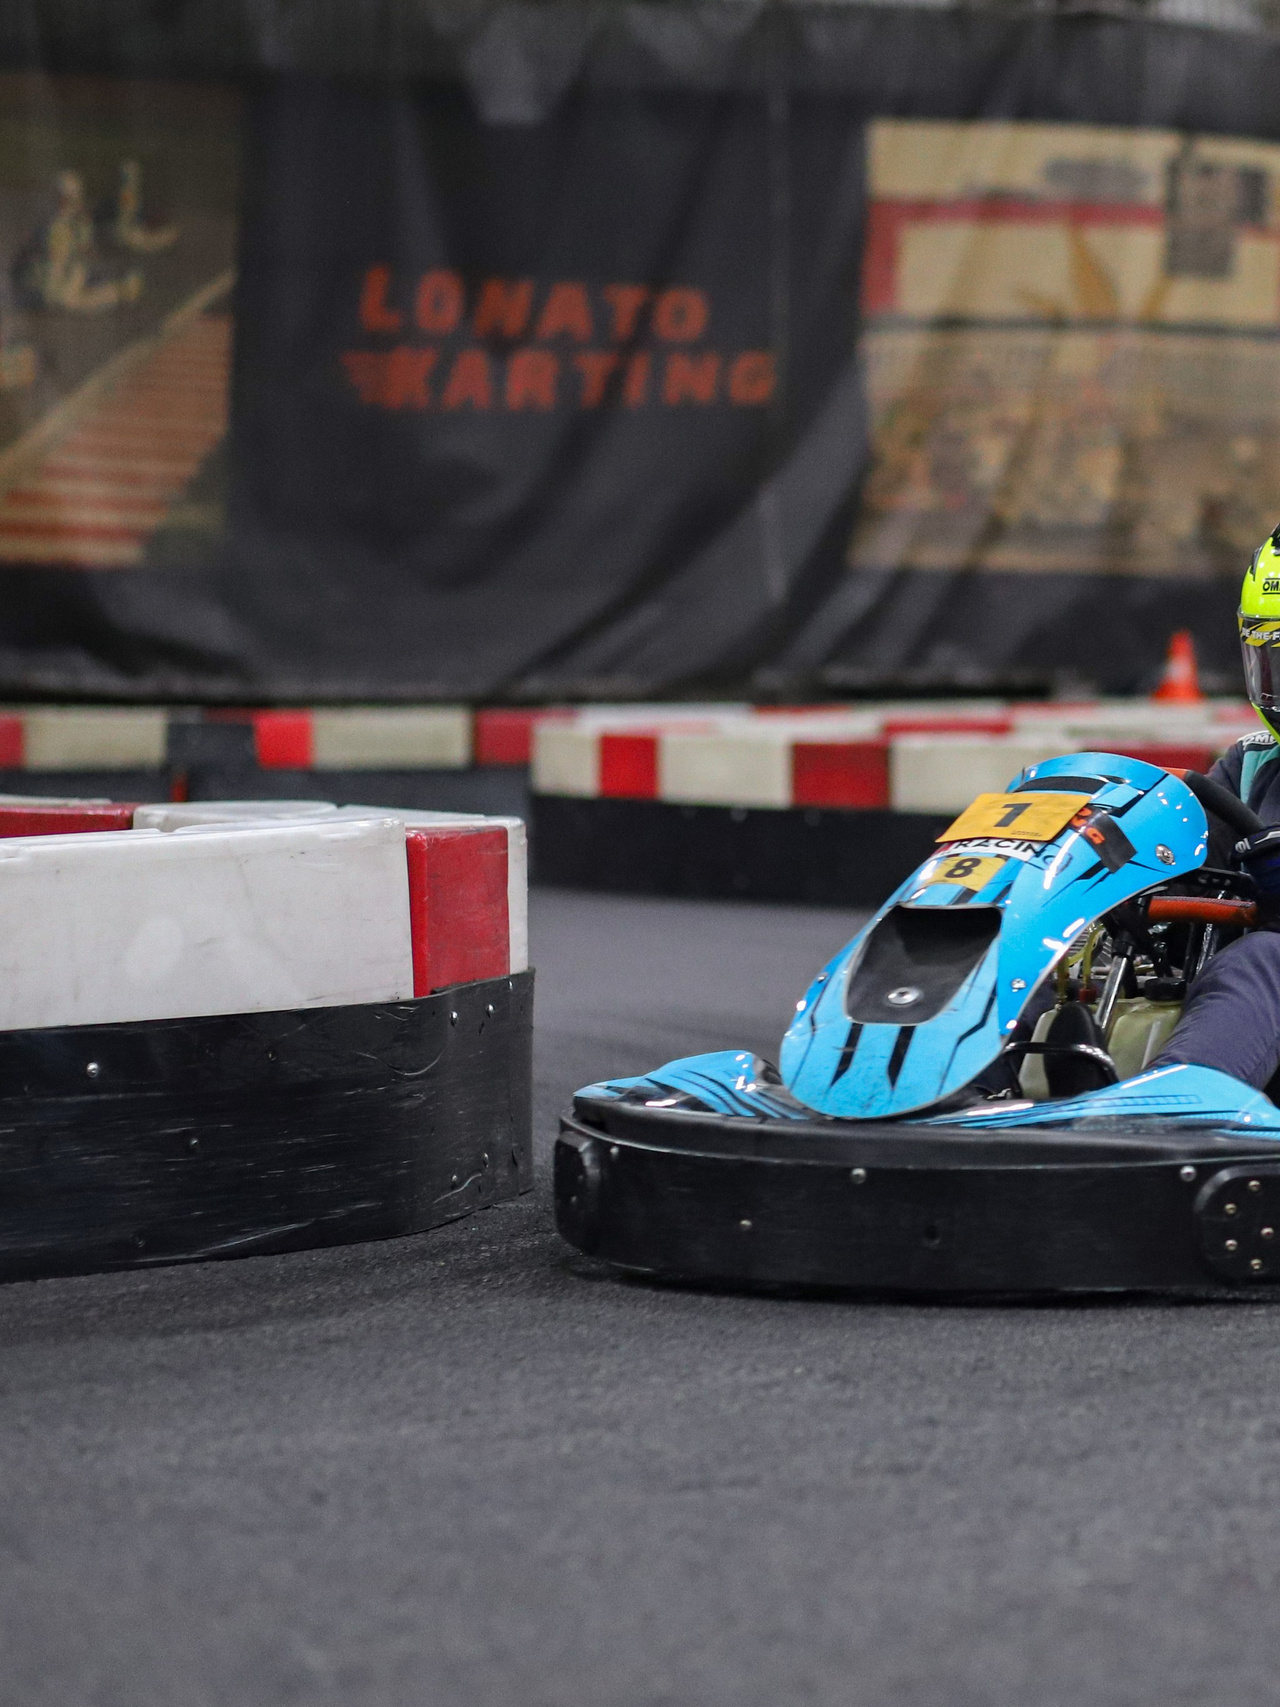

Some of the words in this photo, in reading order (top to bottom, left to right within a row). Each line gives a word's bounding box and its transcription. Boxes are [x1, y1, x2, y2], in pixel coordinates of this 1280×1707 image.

[358, 262, 711, 343] LONATO
[380, 345, 777, 413] KARTING
[1252, 630, 1270, 640] THE
[993, 802, 1033, 828] 1
[944, 857, 982, 879] 8
